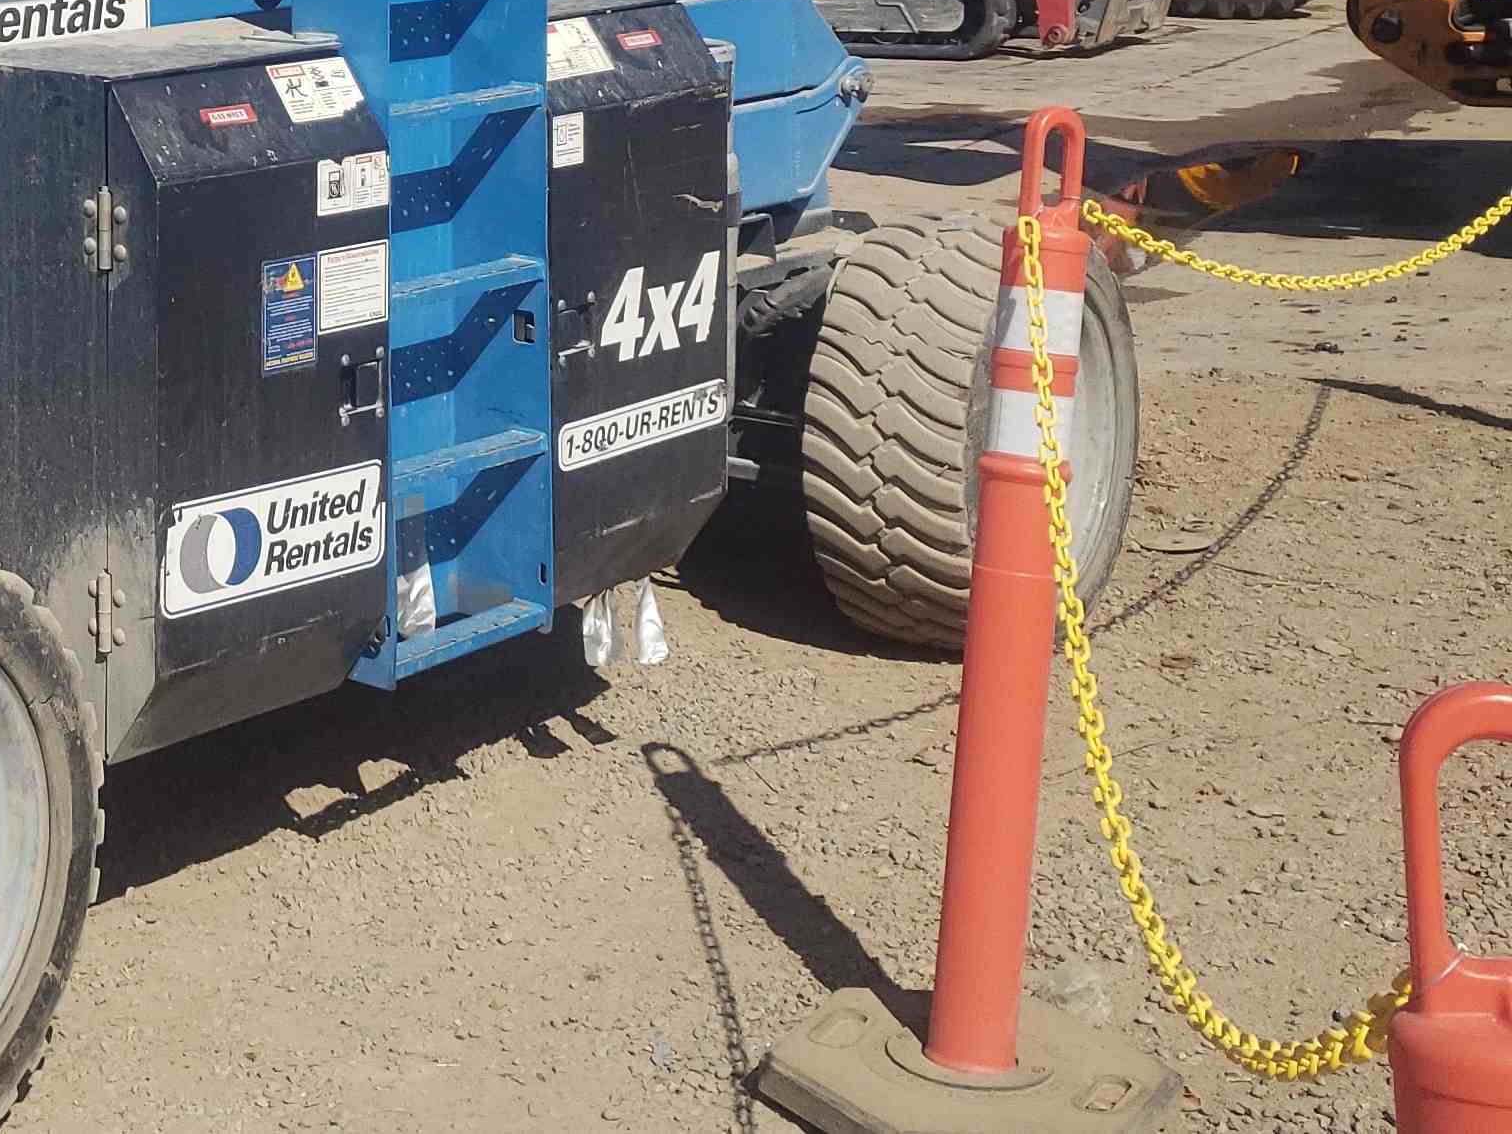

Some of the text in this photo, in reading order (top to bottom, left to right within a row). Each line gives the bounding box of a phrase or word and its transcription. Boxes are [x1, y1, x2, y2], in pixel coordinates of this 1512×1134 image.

[600, 250, 721, 362] 4x4
[566, 393, 718, 459] 1-800-UR-RENTS
[266, 478, 366, 535] United
[264, 521, 374, 576] Rentals
